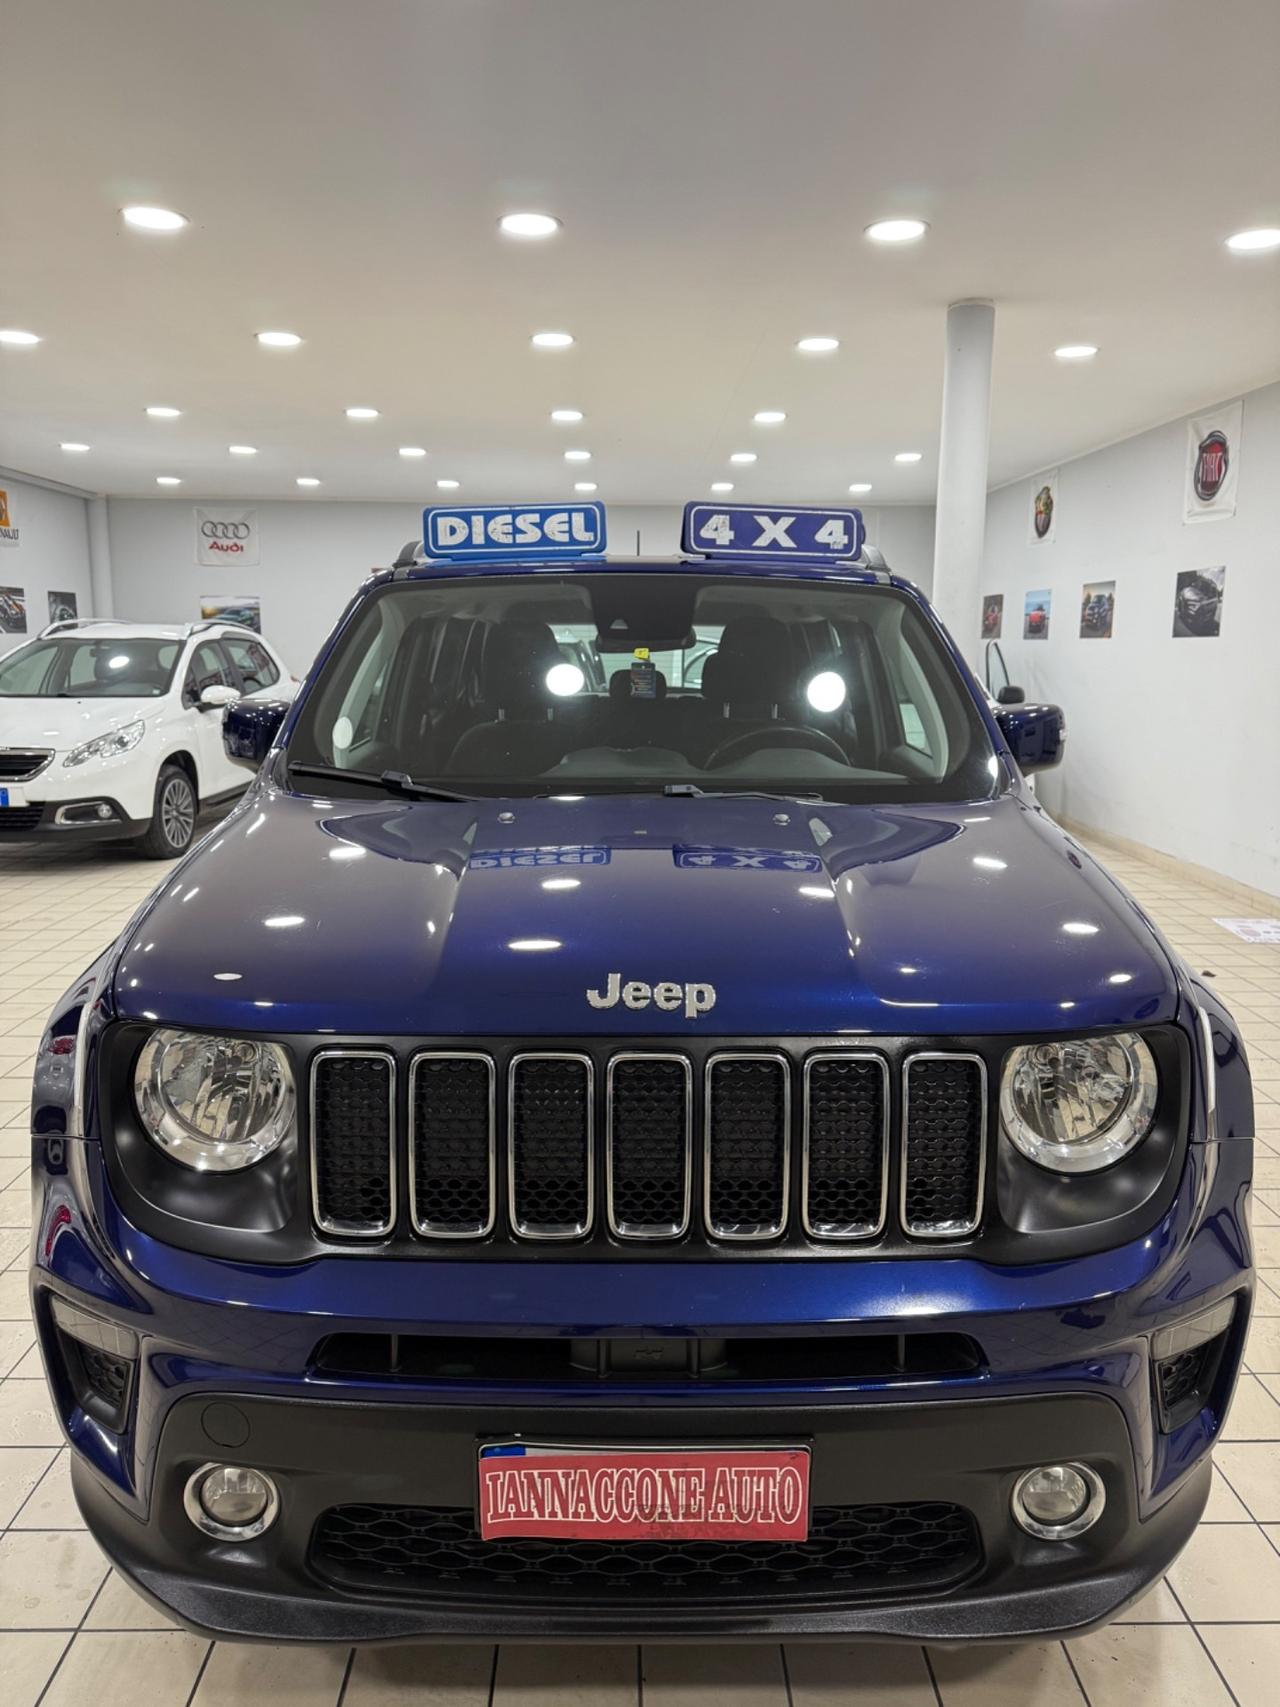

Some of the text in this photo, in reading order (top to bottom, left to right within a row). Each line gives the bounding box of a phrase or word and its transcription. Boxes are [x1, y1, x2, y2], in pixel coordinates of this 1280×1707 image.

[437, 512, 594, 546] DIESEL
[699, 514, 849, 550] 4 X 4
[586, 972, 717, 1019] Jeep
[486, 1466, 802, 1524] IANNACCONE AUTO
